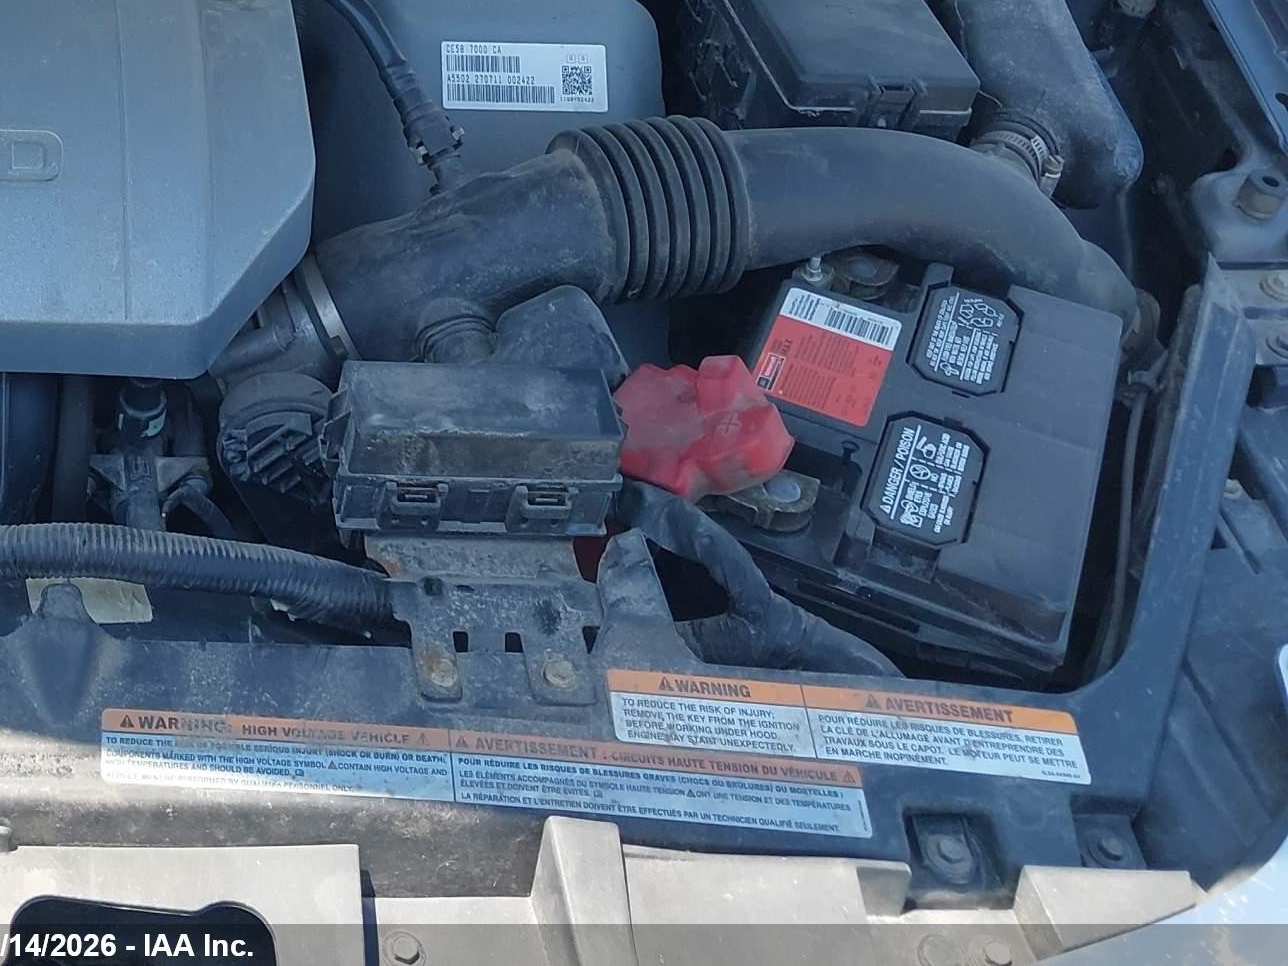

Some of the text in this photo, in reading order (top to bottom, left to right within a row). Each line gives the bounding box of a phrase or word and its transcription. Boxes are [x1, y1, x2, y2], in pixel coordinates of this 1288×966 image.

[492, 44, 503, 55] CA
[882, 466, 903, 505] DANGER
[895, 427, 915, 461] POISON
[675, 679, 751, 697] WARNING
[623, 698, 634, 706] TO
[637, 699, 675, 709] REDUCE
[678, 702, 696, 711] THE
[699, 704, 720, 713] RISK
[723, 706, 736, 715] OF
[885, 698, 1013, 722] AVERTISSEMENT
[625, 719, 663, 730] BEFORE
[666, 722, 712, 734] WORKING
[714, 726, 747, 737] UNDER
[666, 712, 684, 721] THE
[687, 713, 705, 723] KEY
[708, 715, 736, 725] FROM
[738, 718, 757, 727] THE
[758, 720, 800, 731] IGNITION
[818, 715, 844, 724] POUR
[847, 715, 886, 728] RÉDUIRE
[953, 727, 964, 736] DE
[1025, 734, 1063, 746] RETIRER
[119, 736, 155, 745] REDUCE
[243, 723, 277, 736] HIGH
[352, 731, 409, 745] VEHICLE
[687, 734, 716, 745] START
[821, 725, 833, 733] LA
[835, 724, 853, 735] CLÉ
[856, 728, 869, 737] DE
[871, 730, 929, 743] L'ALLUMAGE
[932, 736, 961, 746] AVANT
[1046, 747, 1065, 757] DES
[475, 739, 838, 780] AVERTISSEMENT CIRCUITS HAUTE TENSION DU VÉHICULE
[823, 736, 864, 747] TRAVAUX
[867, 740, 893, 750] SOUS
[897, 743, 908, 752] LE
[948, 748, 960, 757] LE
[1003, 753, 1025, 763] PEUT
[1028, 756, 1041, 765] SE
[1043, 757, 1078, 768] METTRE
[825, 746, 839, 755] EN
[842, 748, 880, 758] MARCHE
[162, 751, 194, 761] MARKED
[197, 753, 218, 763] WITH
[235, 755, 254, 765] HIGH
[256, 757, 291, 767] VOLTAGE
[294, 759, 326, 769] SYMBOL
[338, 762, 371, 772] CONTAIN
[373, 764, 392, 773] HIGH
[394, 765, 429, 775] VOLTAGE
[431, 767, 447, 776] AND
[191, 762, 208, 771] AND
[210, 763, 241, 773] SHOULD
[458, 757, 481, 766] POUR
[484, 757, 520, 769] RÉDUIRE
[523, 763, 538, 771] LES
[541, 764, 577, 774] RISQUES
[593, 769, 640, 780] BLESSURES
[643, 773, 676, 783] GRAVES
[696, 790, 710, 799] ONT
[473, 791, 520, 804] RÉPARATION
[583, 802, 615, 812] DOIVENT
[617, 803, 636, 814] ÊTRE
[684, 811, 698, 819] PAR
